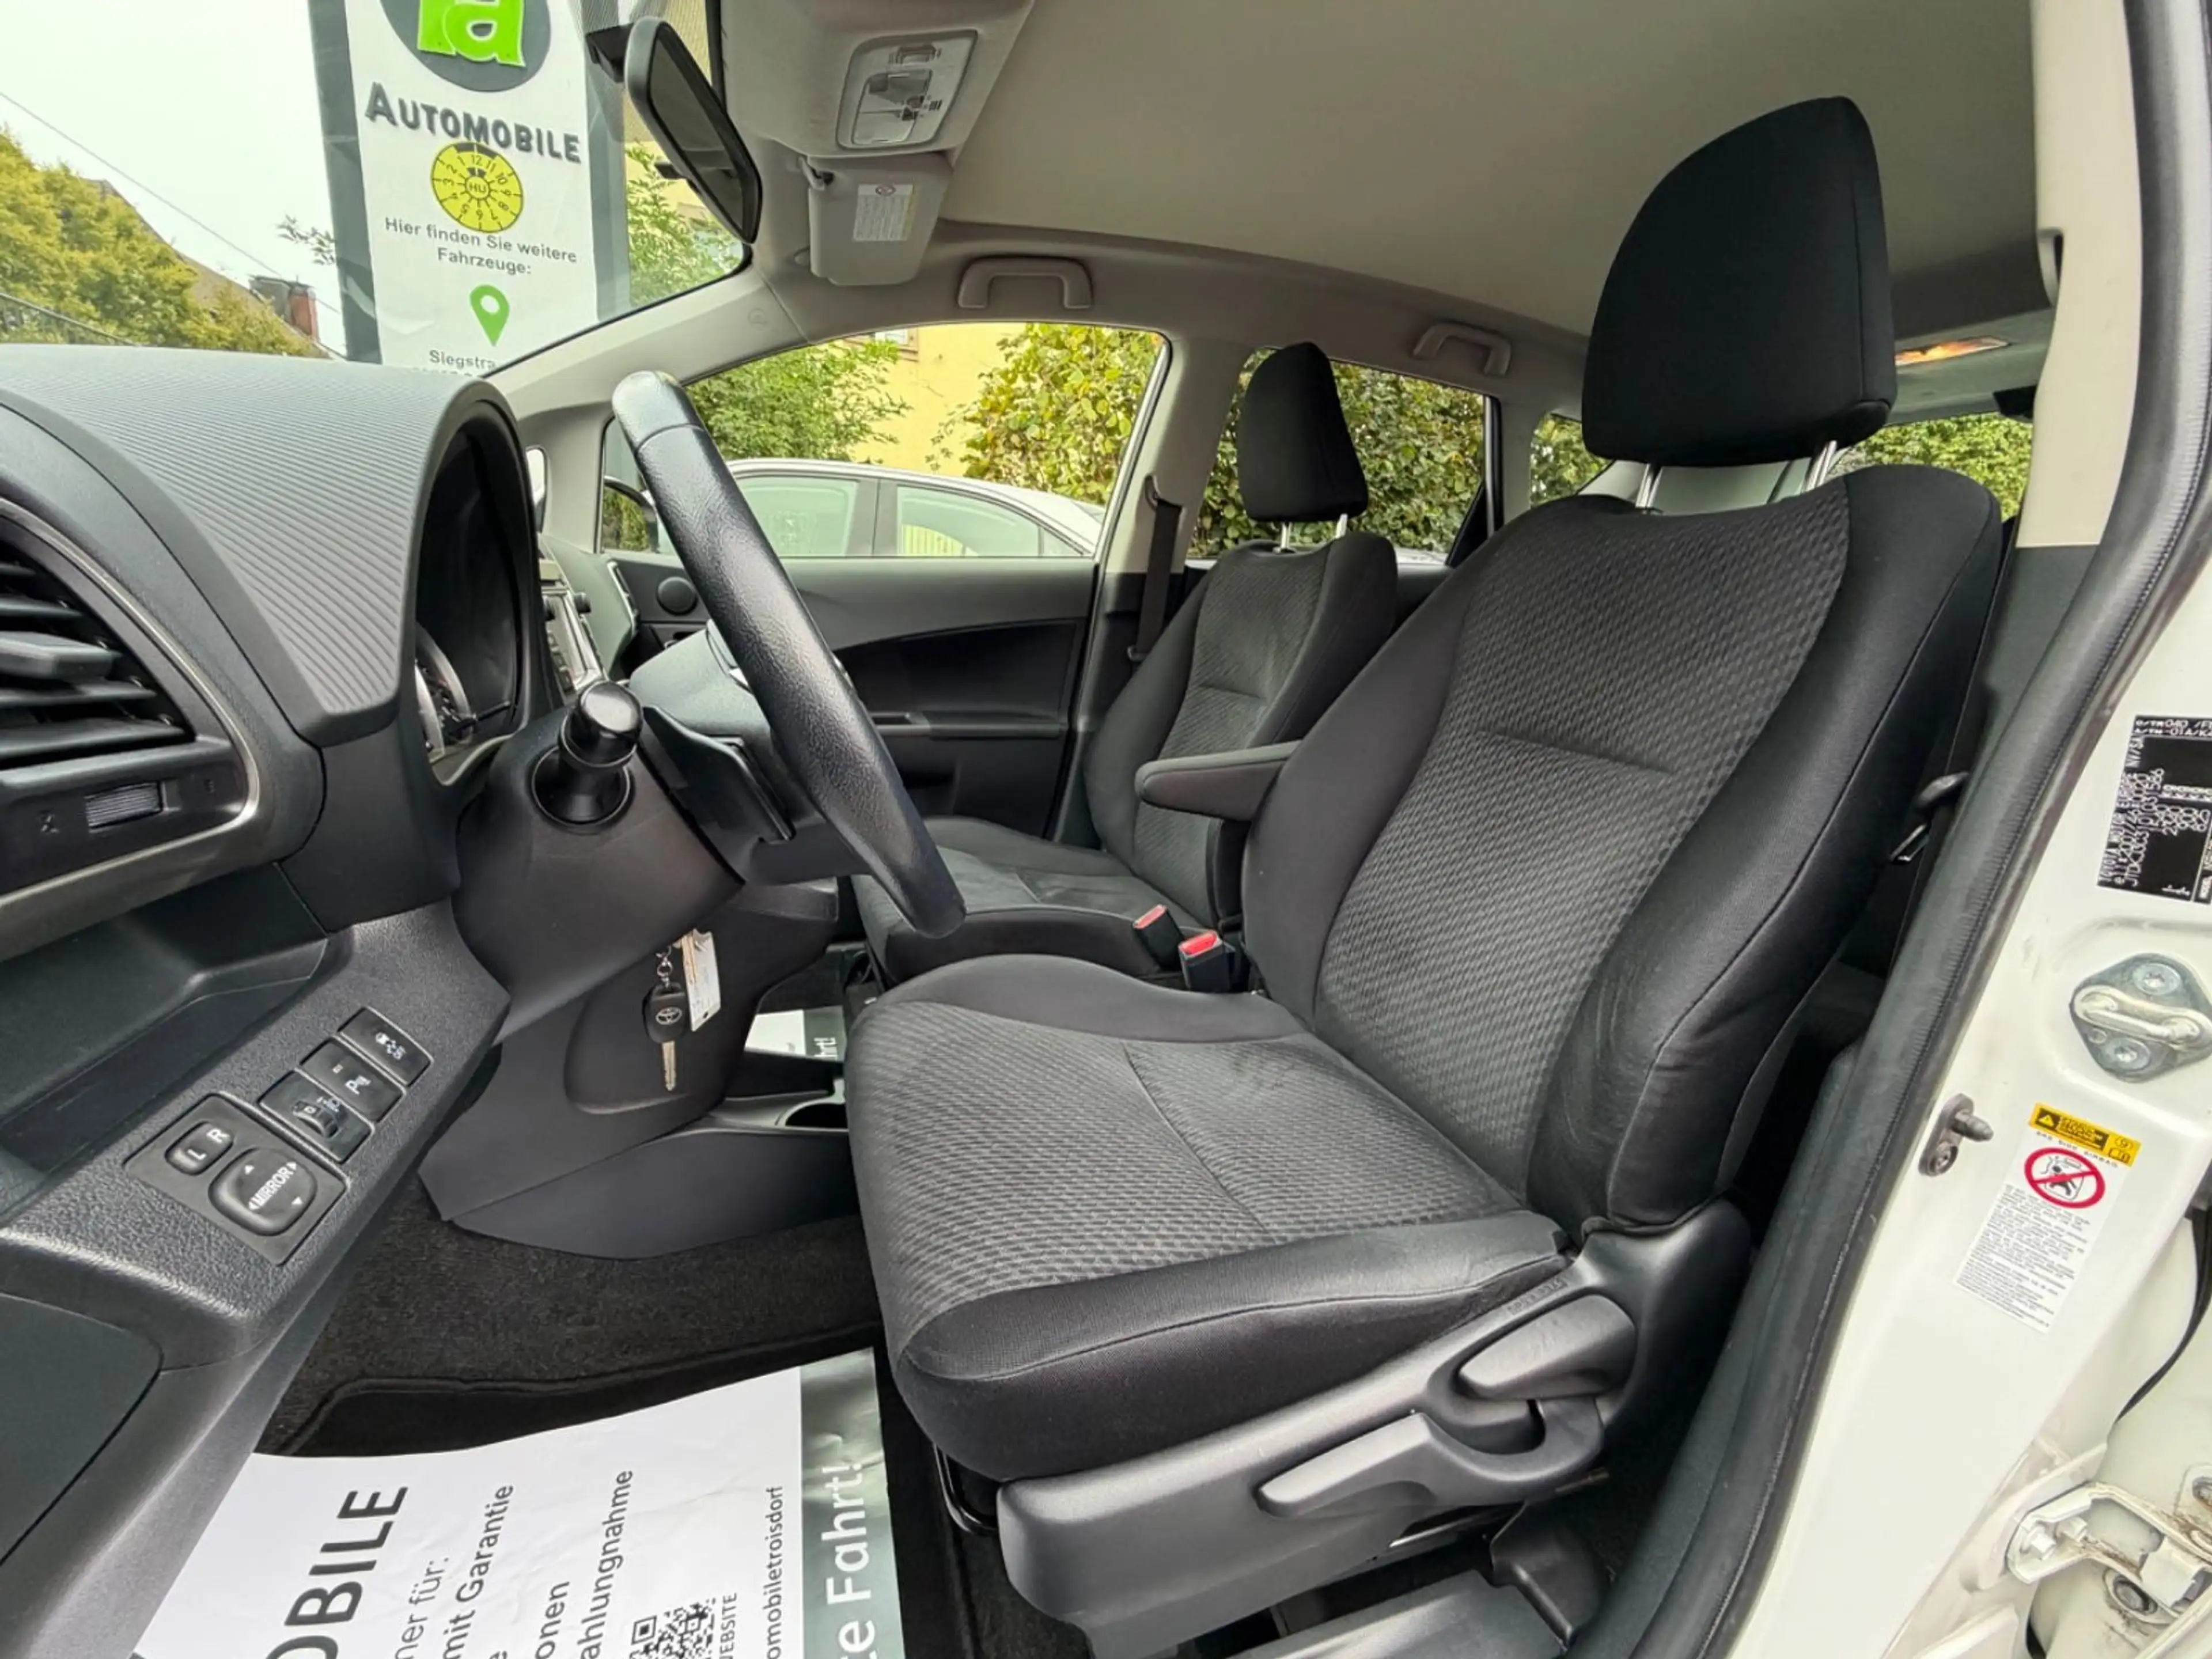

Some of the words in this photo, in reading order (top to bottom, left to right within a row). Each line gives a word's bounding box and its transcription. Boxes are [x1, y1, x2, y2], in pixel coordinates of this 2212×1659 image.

[365, 81, 582, 164] AUTOMOBILE
[471, 154, 483, 166] 12
[469, 182, 487, 193] HU
[385, 217, 421, 236] Hier
[426, 224, 480, 246] finden
[487, 235, 512, 252] Sie
[517, 243, 577, 263] weitere
[437, 246, 531, 276] Fahrzeuge:
[187, 1149, 207, 1161] L
[206, 1128, 230, 1144] R
[250, 1166, 295, 1207] MIRROR
[455, 1484, 514, 1604] Garantie
[820, 1462, 872, 1605] Fahrt!
[408, 1556, 449, 1605] für:
[719, 1592, 737, 1659] EBSITE
